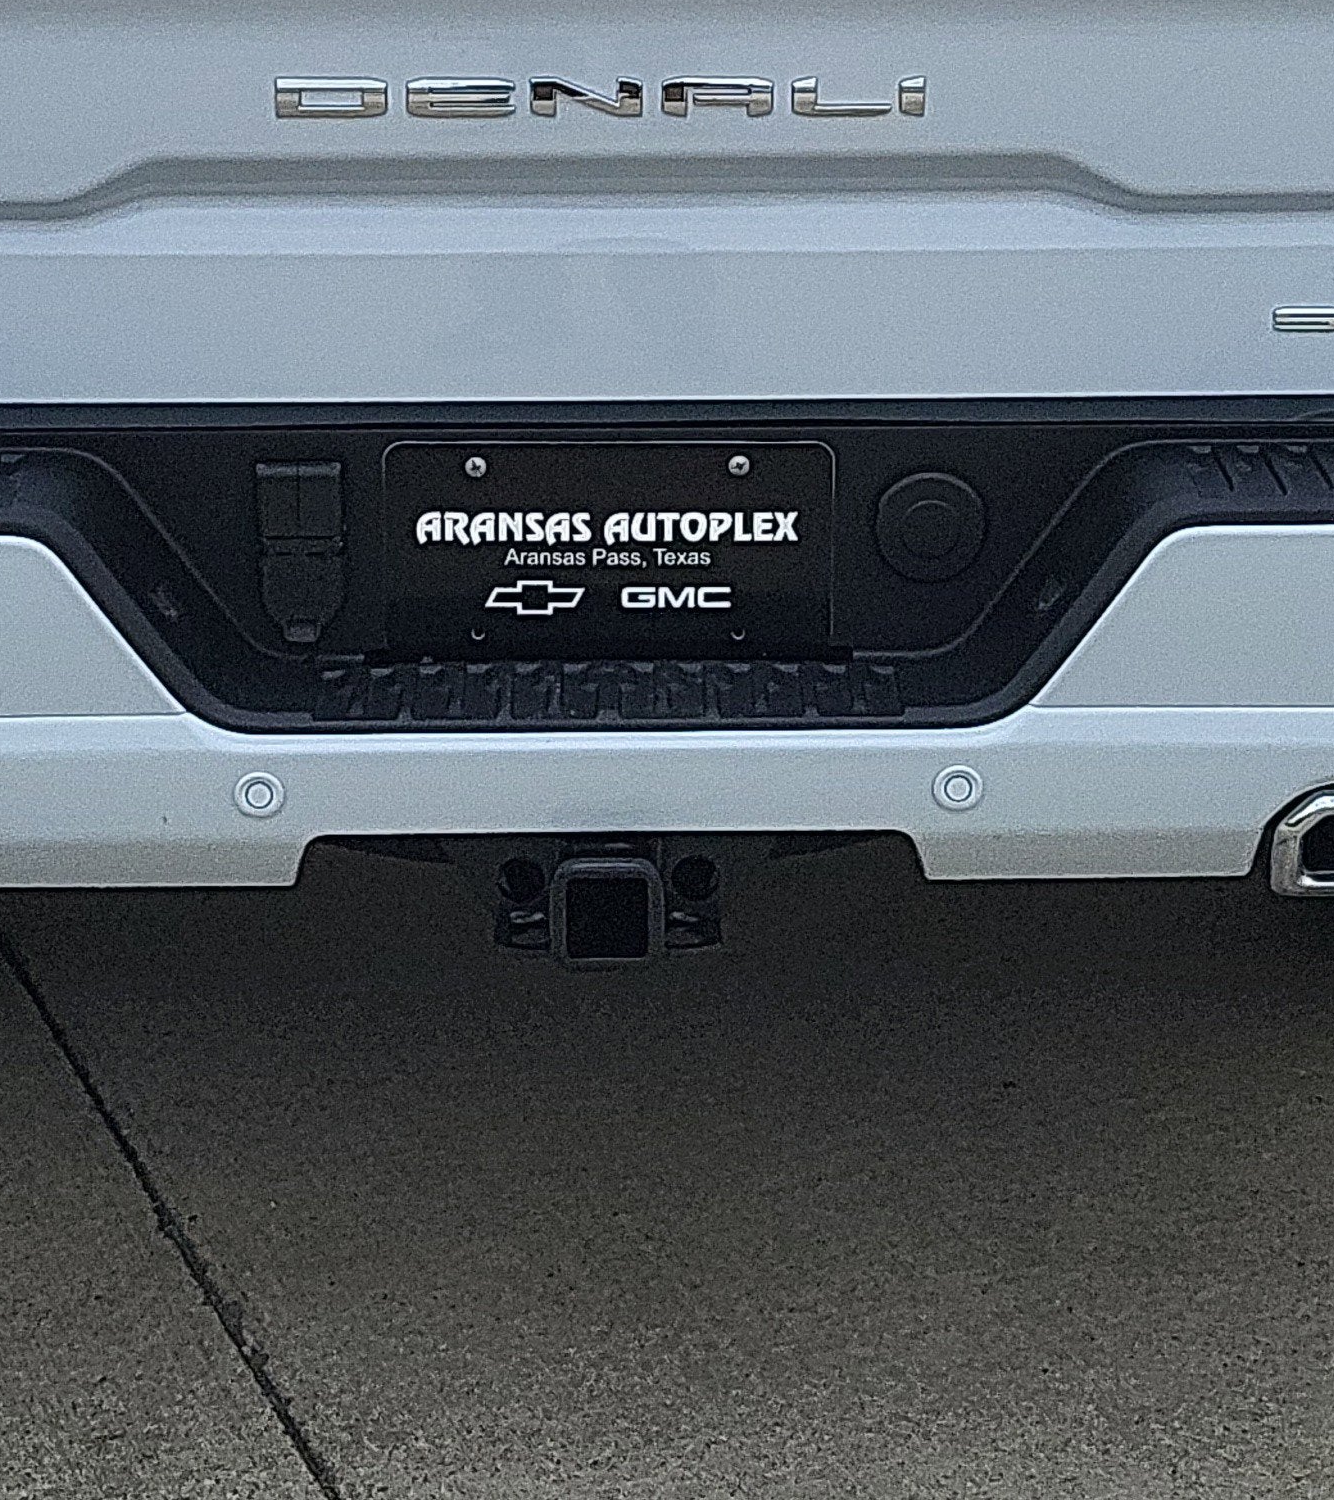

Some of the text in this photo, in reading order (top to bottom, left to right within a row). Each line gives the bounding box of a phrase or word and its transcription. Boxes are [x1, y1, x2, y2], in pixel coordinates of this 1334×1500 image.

[274, 75, 928, 118] DENALI
[416, 511, 799, 546] ARANSAS AUTOPLEX
[504, 549, 712, 568] Aransas Pass, Texas
[620, 586, 732, 609] GMC
